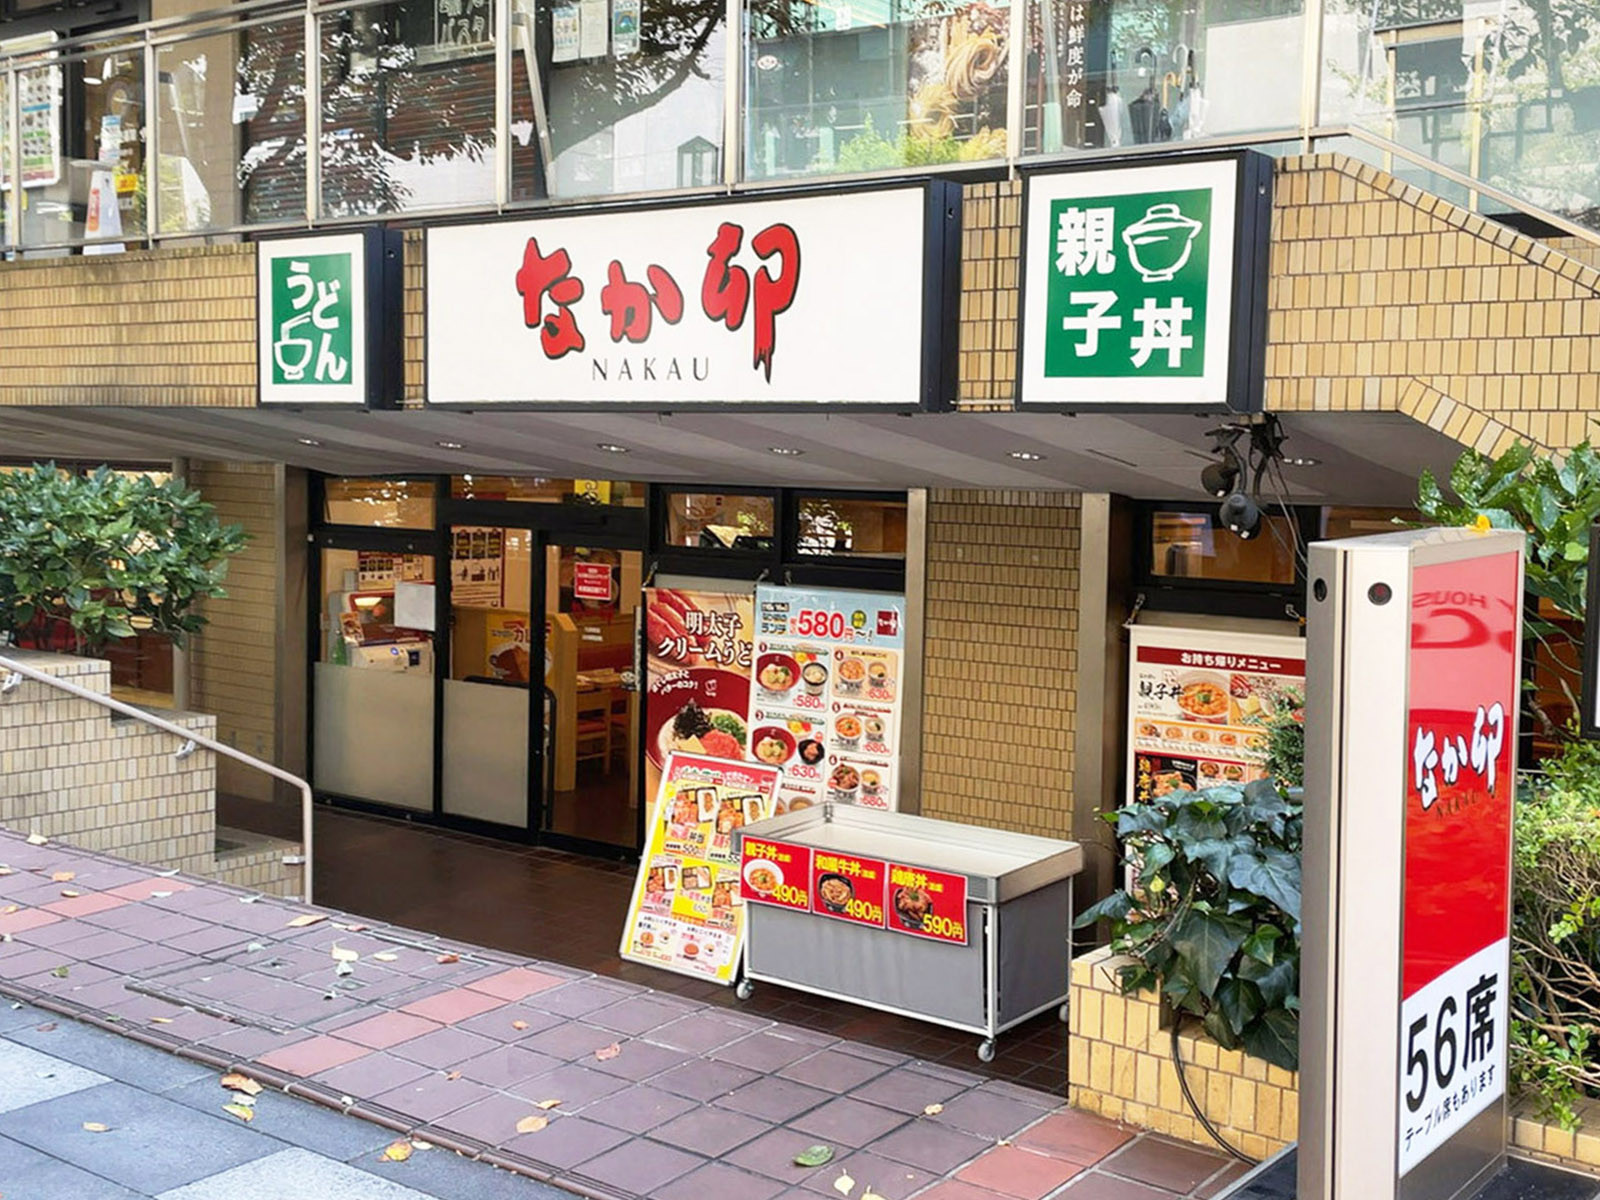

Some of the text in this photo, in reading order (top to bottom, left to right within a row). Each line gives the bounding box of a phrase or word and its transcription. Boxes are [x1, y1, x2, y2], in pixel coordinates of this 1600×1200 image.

[1066, 3, 1085, 109] は鮮度が命
[516, 222, 801, 384] なか卯
[286, 260, 348, 382] うどん
[592, 357, 709, 381] NAKAU
[685, 610, 743, 640] 明太子
[1181, 652, 1281, 671] お持ち帰りメニュー
[1413, 701, 1505, 811] なか卯
[745, 841, 777, 860] 親子丼
[772, 884, 808, 907] 490円
[845, 898, 882, 923] 490円
[923, 914, 964, 939] 590円
[1406, 973, 1499, 1113] 56席
